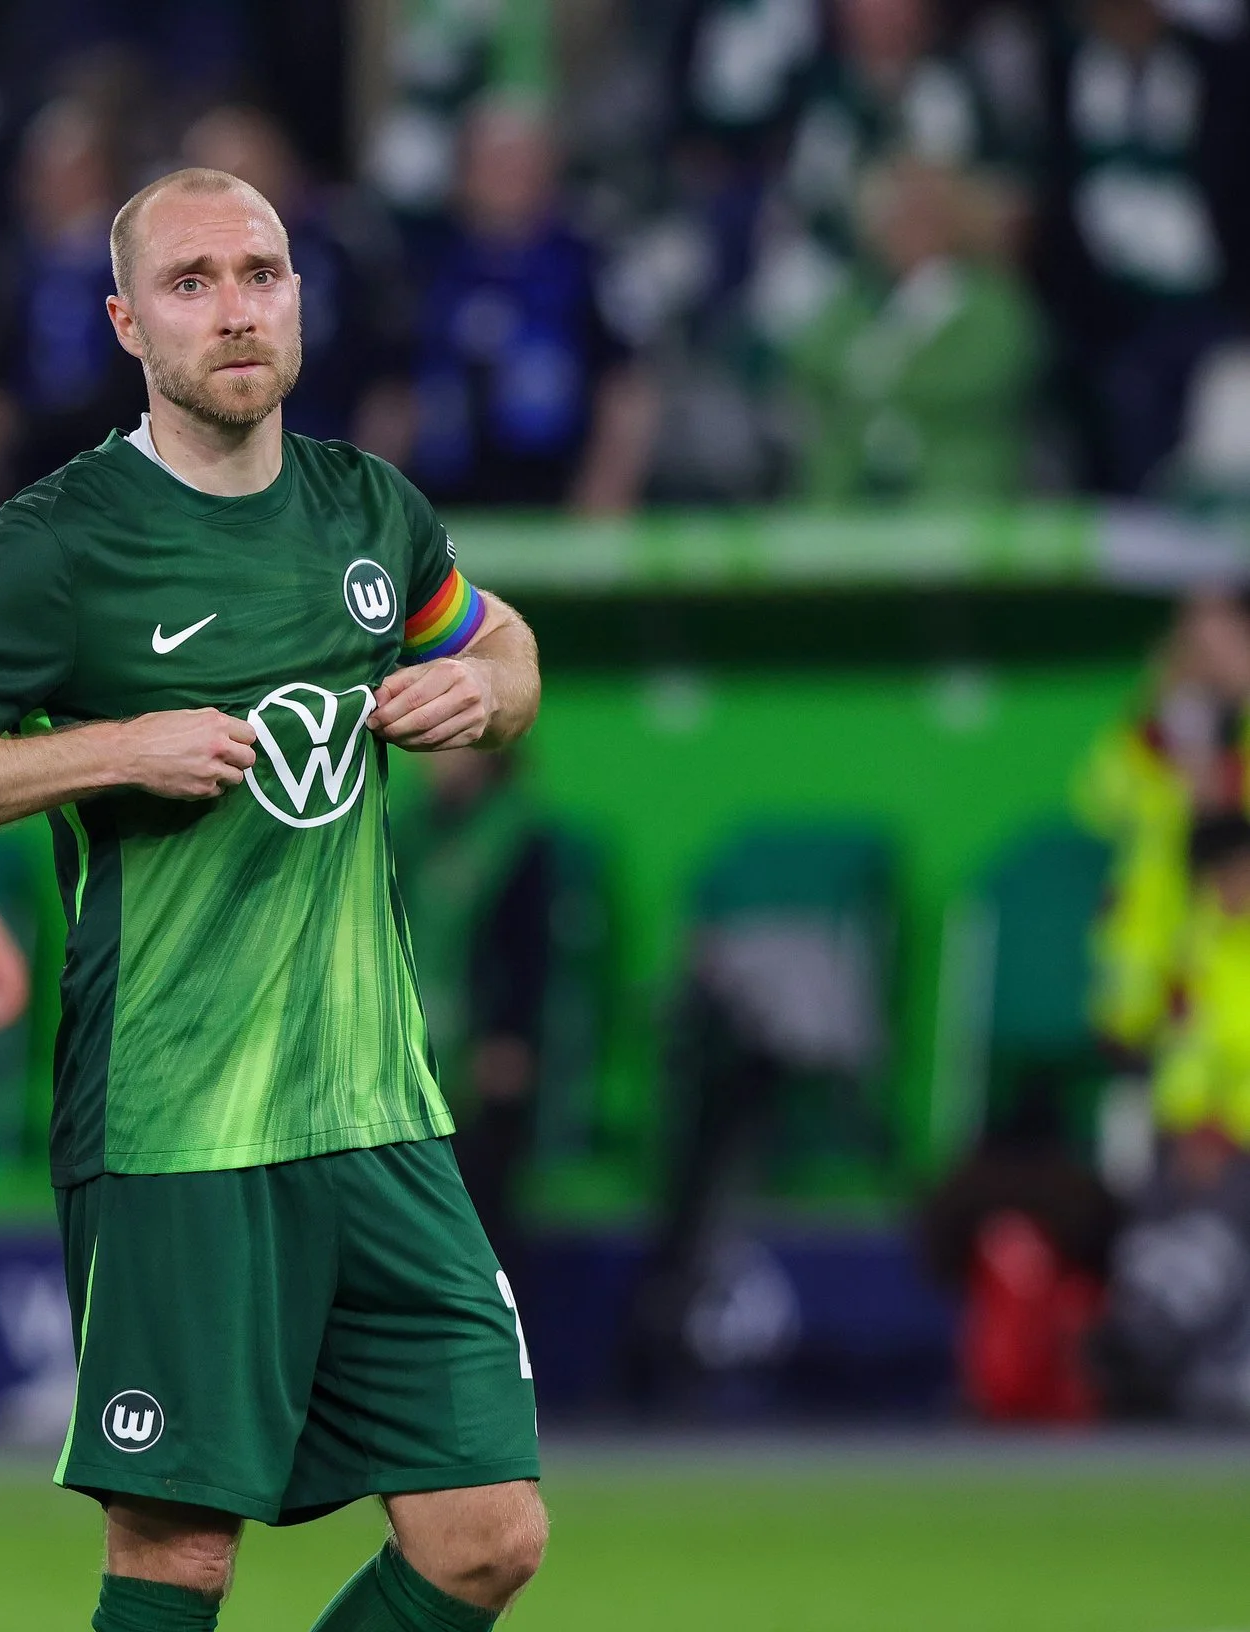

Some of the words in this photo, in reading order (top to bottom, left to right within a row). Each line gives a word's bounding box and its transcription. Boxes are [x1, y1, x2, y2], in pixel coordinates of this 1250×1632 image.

[351, 577, 391, 620] W
[246, 682, 377, 815] VW
[112, 1404, 155, 1442] W
